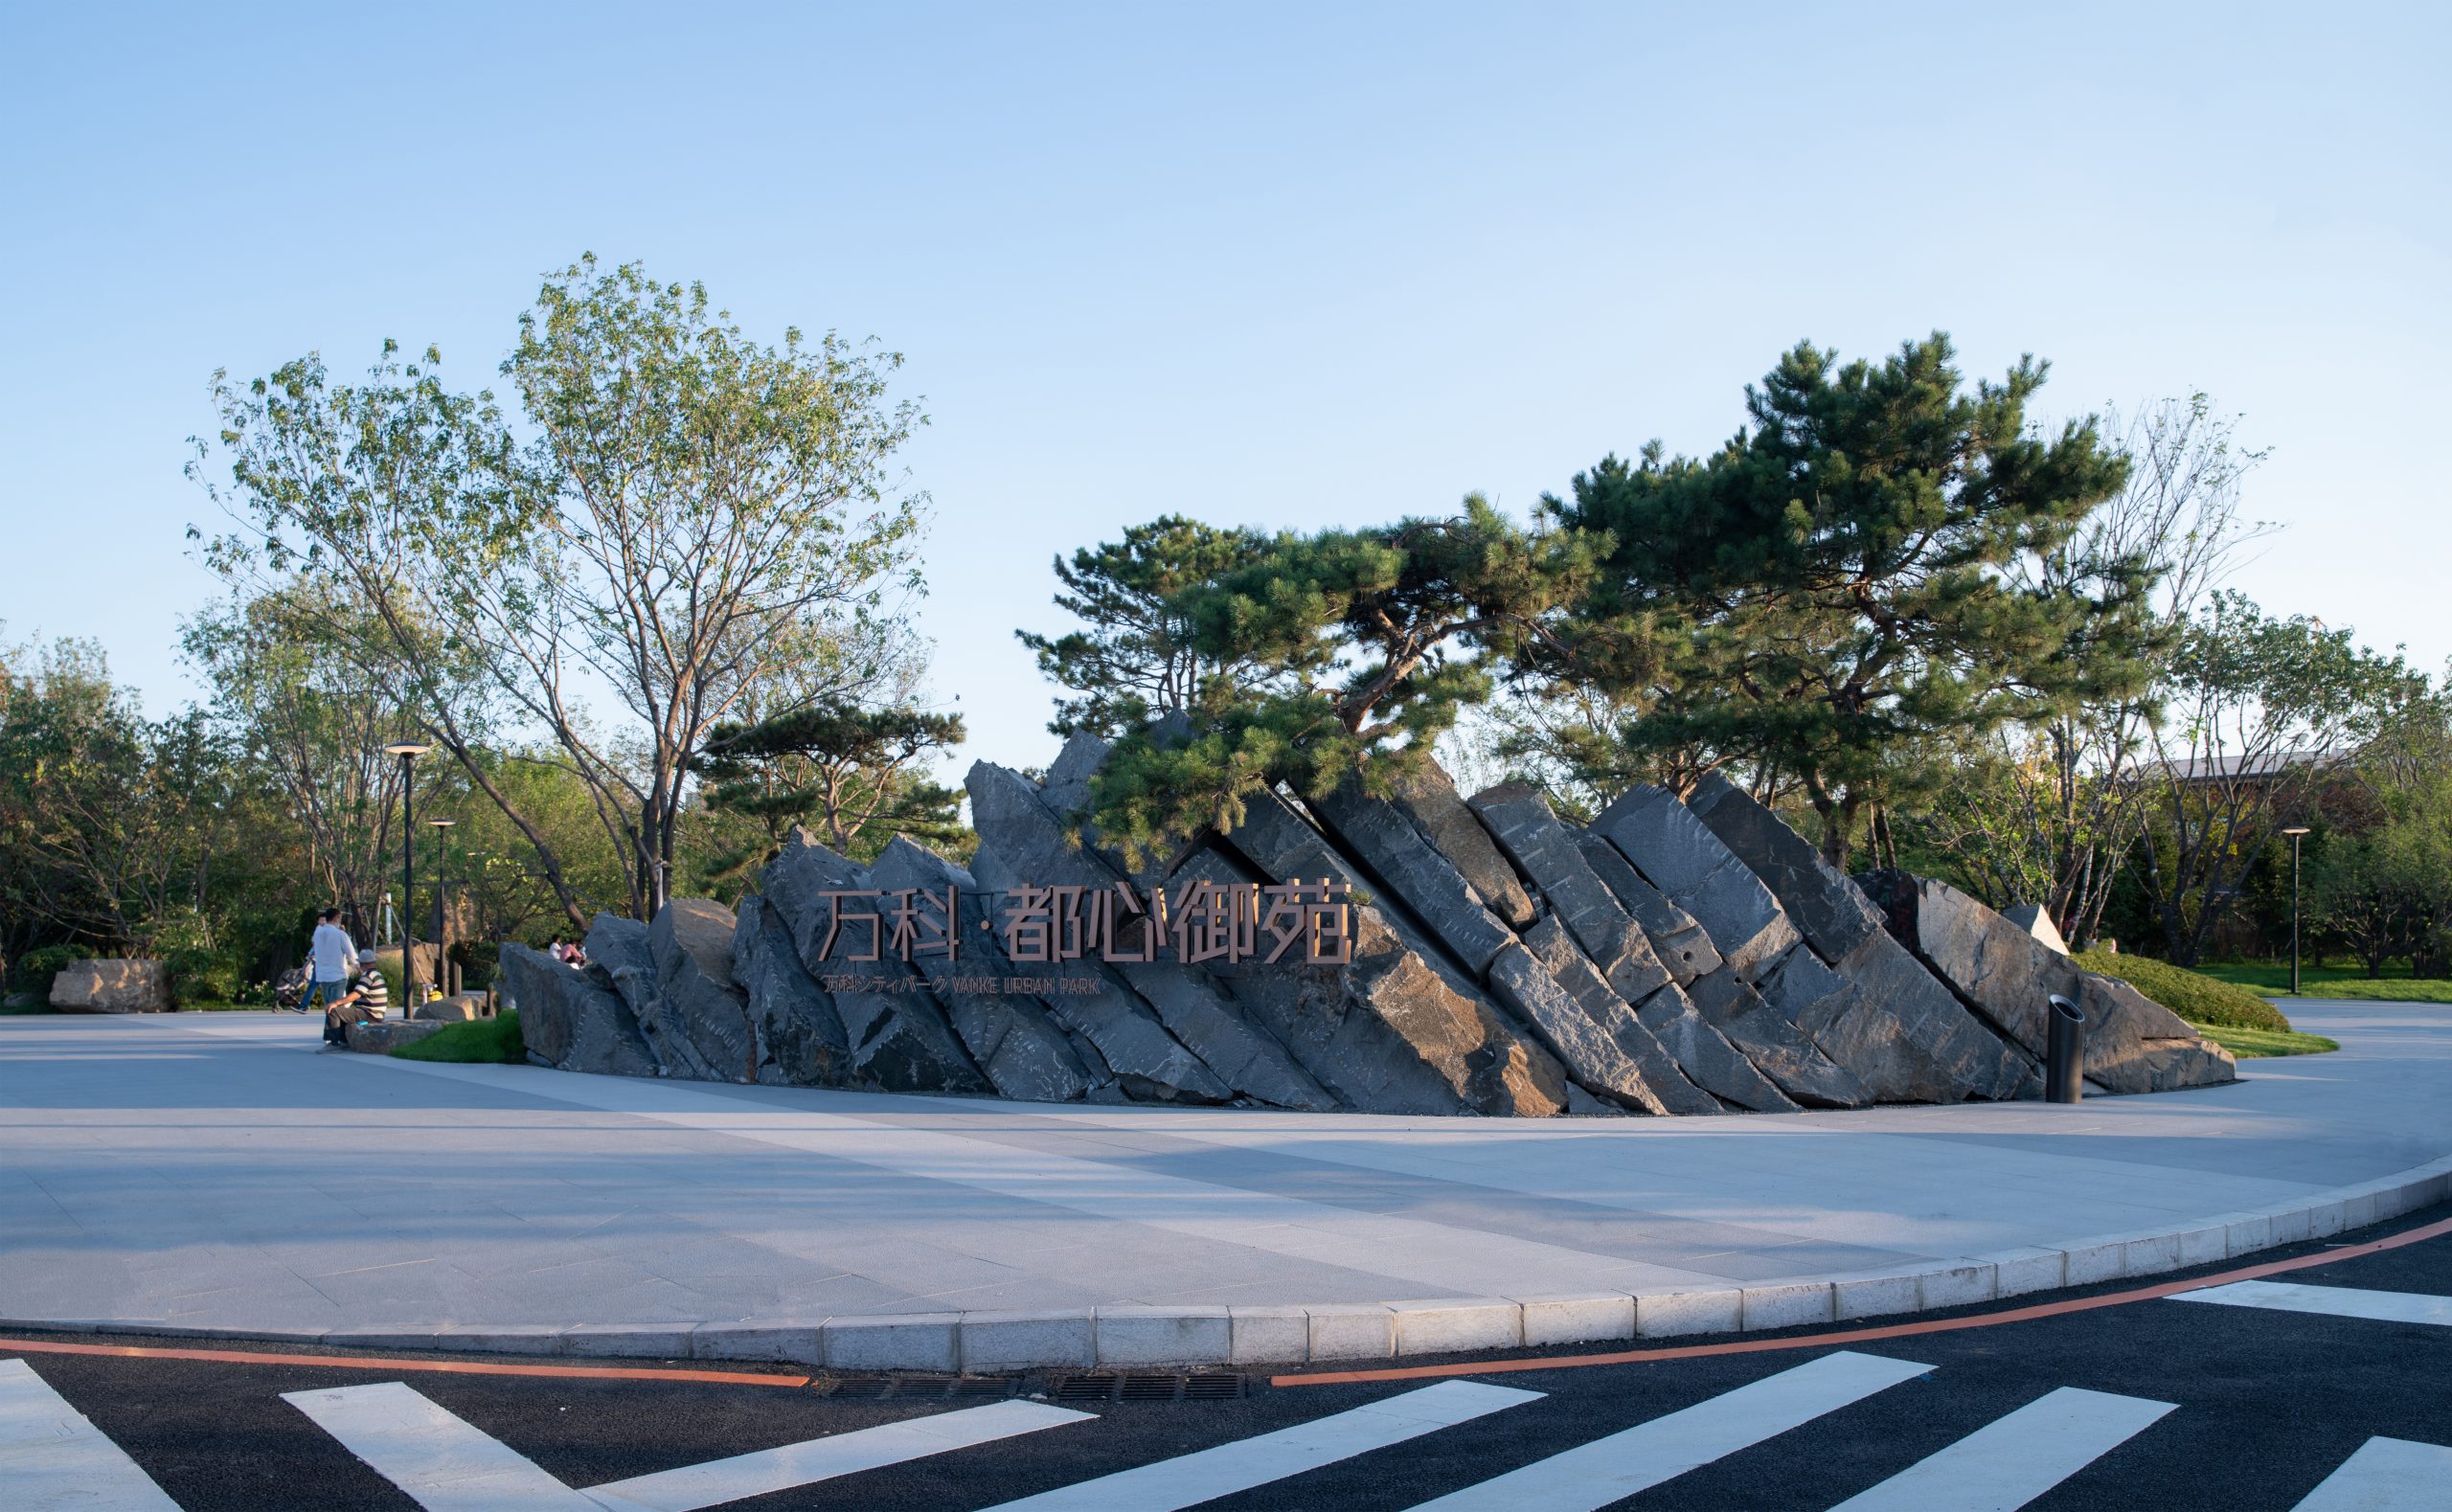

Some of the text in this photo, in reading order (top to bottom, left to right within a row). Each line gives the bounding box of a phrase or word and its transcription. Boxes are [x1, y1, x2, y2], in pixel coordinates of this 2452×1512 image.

[822, 974, 1101, 995] 万科シティパーク VANKE URBAN PARK
